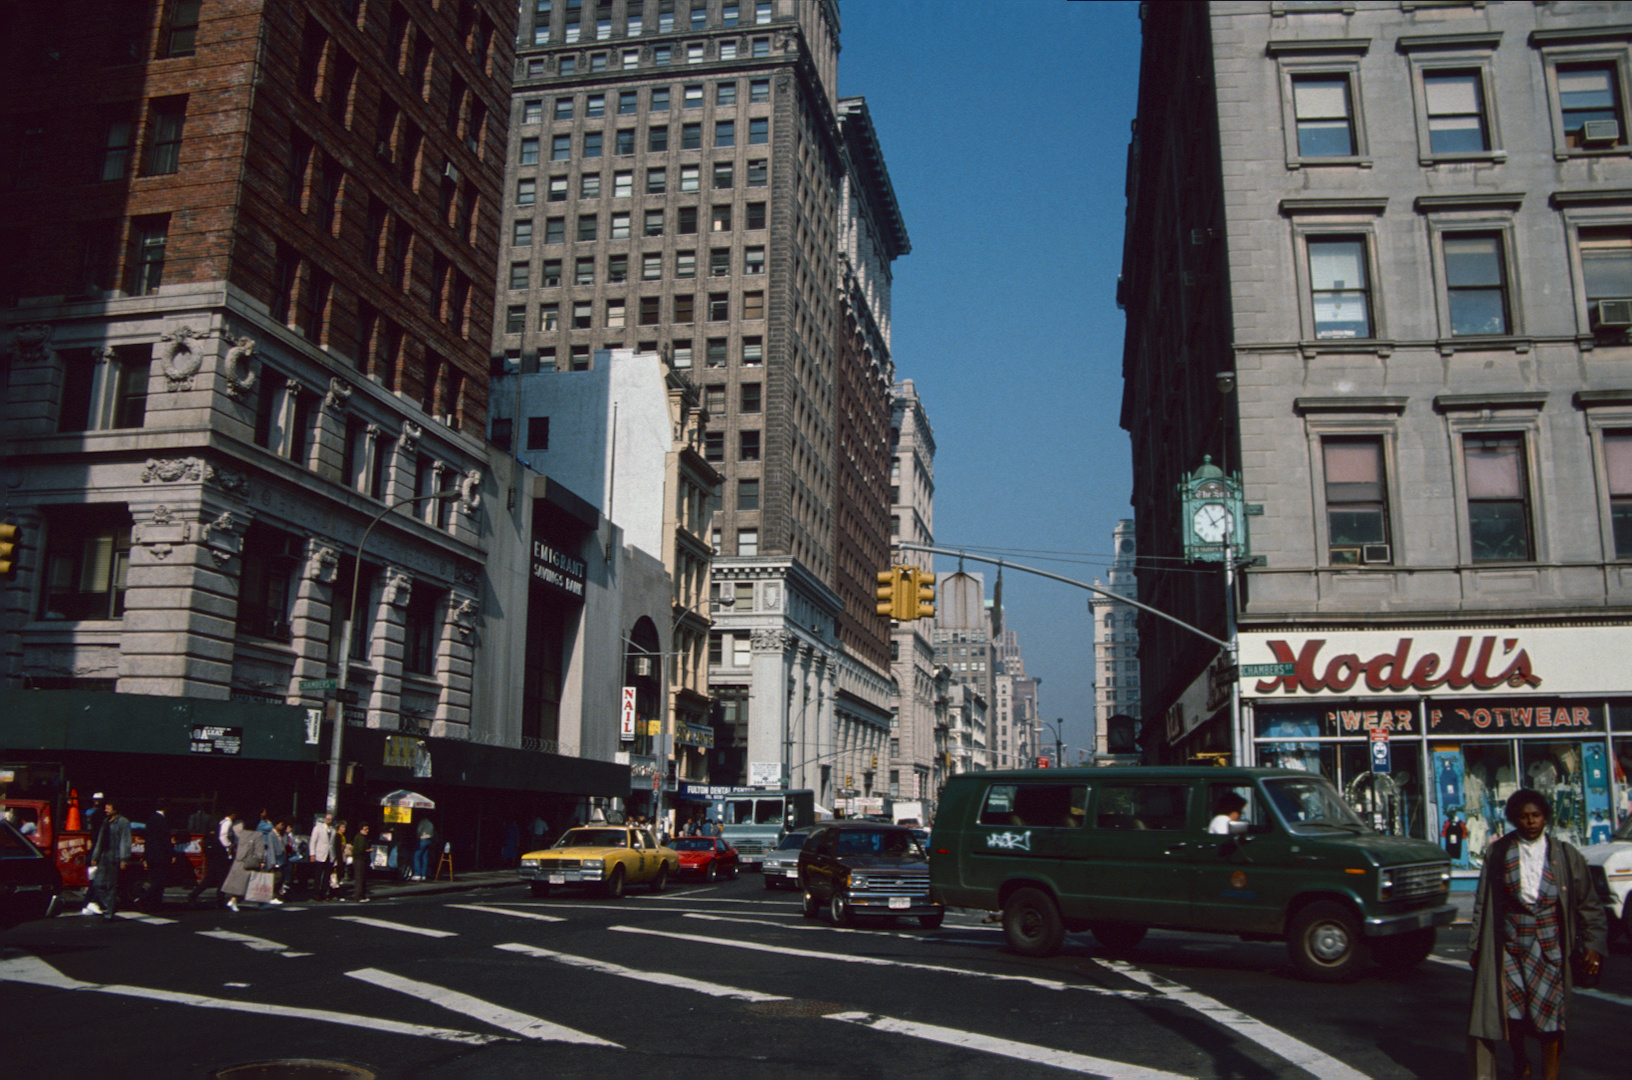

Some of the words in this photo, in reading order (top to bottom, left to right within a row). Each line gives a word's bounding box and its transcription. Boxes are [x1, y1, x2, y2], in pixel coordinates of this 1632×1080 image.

[534, 541, 584, 578] EMIGRANT
[534, 563, 563, 587] SAVINGS
[565, 577, 582, 596] BANK
[1243, 664, 1285, 675] CHAMBERS
[1255, 635, 1542, 693] Modell's
[301, 680, 330, 689] CHAMBERS
[624, 689, 633, 732] NAIL
[1341, 710, 1412, 730] WEAR
[687, 785, 708, 794] FULTON
[710, 786, 731, 795] DENTAL
